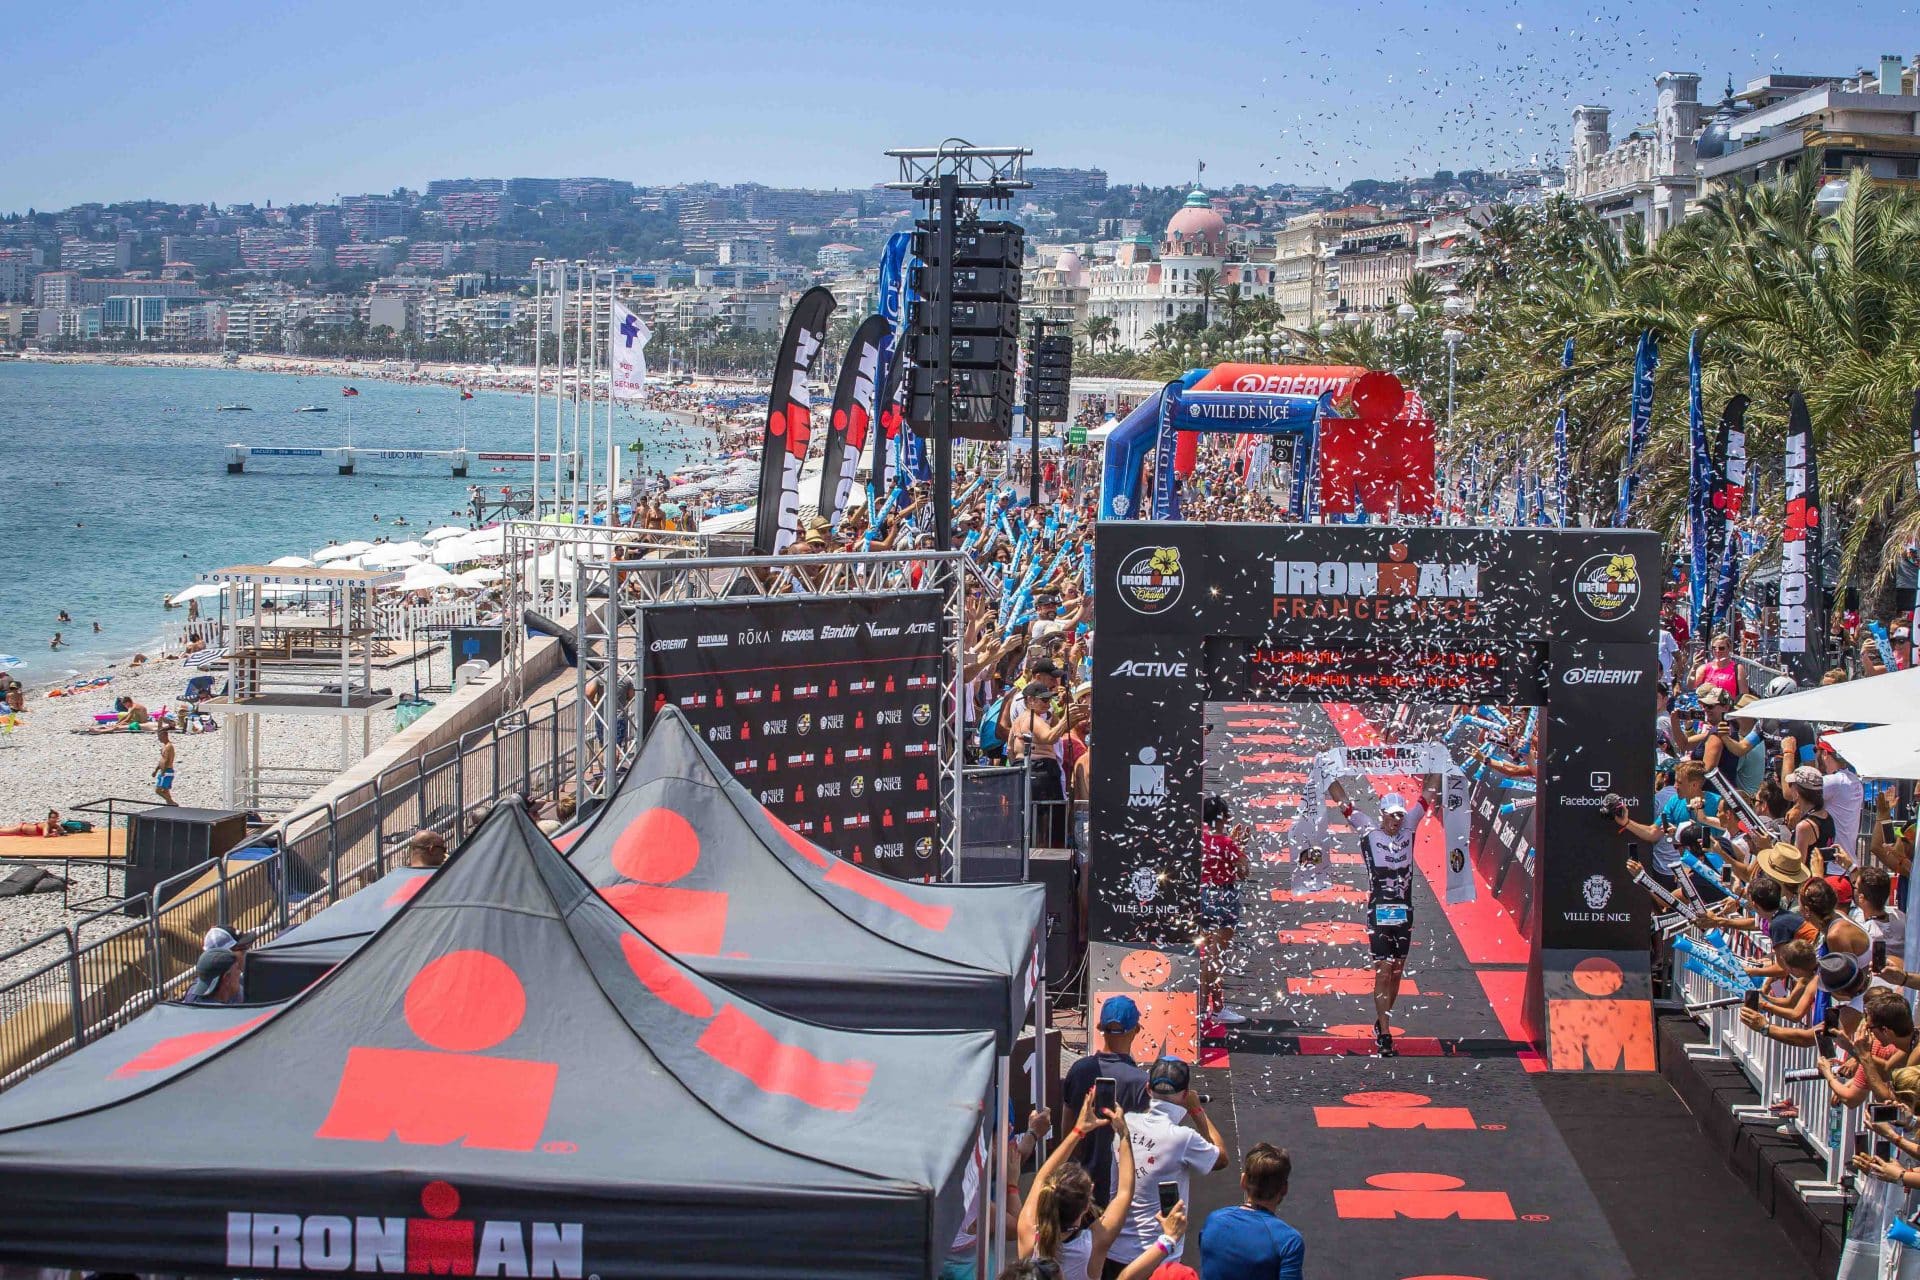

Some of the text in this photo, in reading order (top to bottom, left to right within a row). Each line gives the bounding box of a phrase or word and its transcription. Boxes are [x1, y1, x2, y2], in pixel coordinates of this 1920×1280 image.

[1202, 404, 1289, 419] VILLE DE NICE
[1160, 444, 1173, 467] DE
[1273, 543, 1479, 597] IRONMAN
[203, 575, 251, 583] POSTE
[294, 578, 366, 587] SECOURS
[1122, 570, 1180, 586] IRONMAN
[1578, 577, 1636, 593] IRONMAN
[1273, 598, 1479, 621] FRANCE NICE
[662, 639, 688, 650] ENERVIT
[820, 624, 860, 639] Santini
[904, 623, 935, 634] ACTIVE
[1110, 659, 1188, 677] ACTIVE
[1584, 669, 1642, 684] ENERVIT
[771, 726, 787, 734] NICE
[825, 788, 840, 797] NICE
[883, 782, 901, 790] NICE
[768, 794, 784, 803] NICE
[1127, 795, 1164, 807] NOW
[1621, 796, 1639, 806] atch
[884, 850, 904, 858] NICE
[1112, 904, 1180, 913] VILLE DE NICE
[1563, 912, 1631, 922] VILLE DE NICE
[1132, 1133, 1156, 1152] EAM
[226, 1180, 583, 1278] IRONMAN
